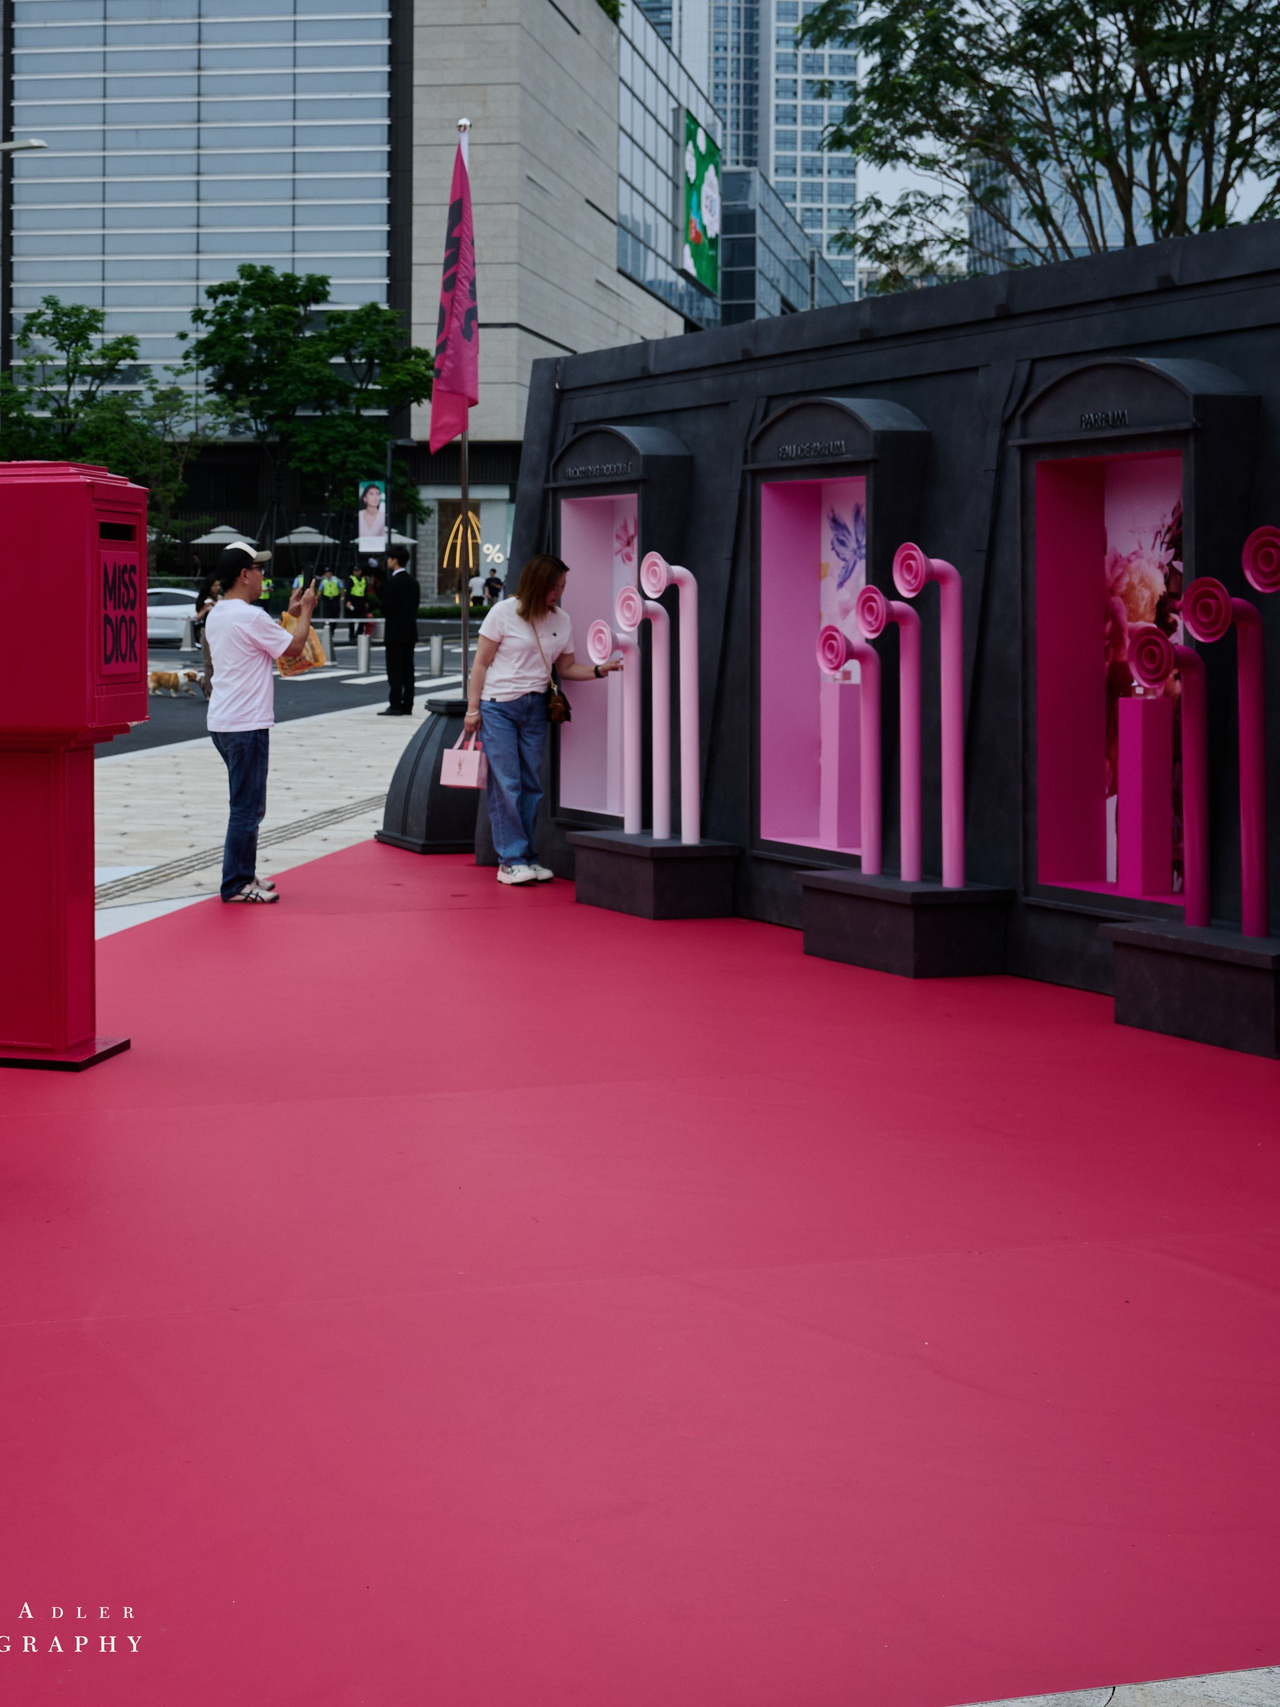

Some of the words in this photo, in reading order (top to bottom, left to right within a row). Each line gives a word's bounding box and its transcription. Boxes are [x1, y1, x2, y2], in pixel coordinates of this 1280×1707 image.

[1080, 409, 1129, 429] PARFUM
[103, 562, 137, 611] MISS
[103, 613, 137, 665] DIOR
